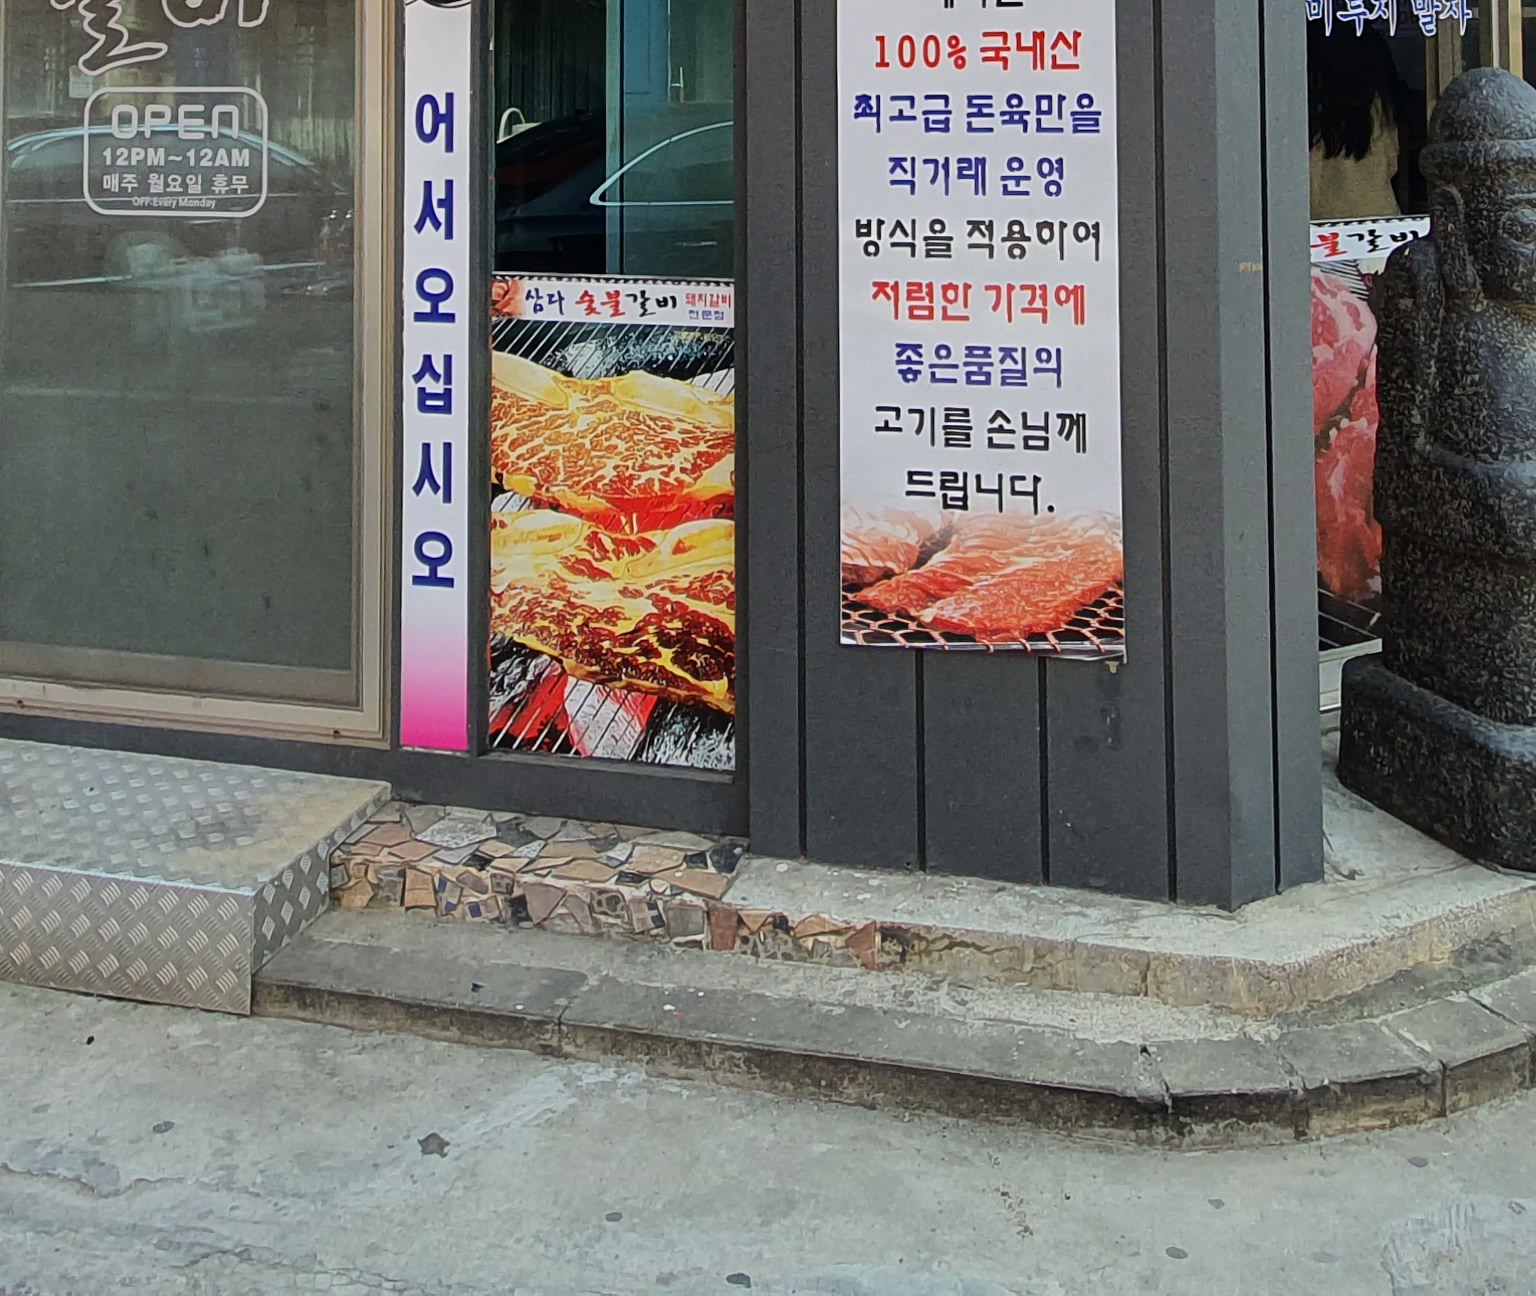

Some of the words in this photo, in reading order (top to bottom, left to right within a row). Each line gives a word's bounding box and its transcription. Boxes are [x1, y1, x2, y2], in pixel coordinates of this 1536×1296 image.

[874, 34, 967, 71] 100%
[979, 30, 1083, 71] 국내산
[112, 104, 239, 140] OPEN
[854, 93, 953, 134] 최고급
[965, 92, 1103, 135] 돈육만을
[102, 148, 250, 167] 12PM~12AM
[888, 156, 987, 197] 직거래
[1000, 156, 1064, 197] 운영
[103, 173, 139, 193] 매주
[148, 173, 202, 194] 월요일
[211, 174, 249, 194] 휴무
[855, 218, 954, 259] 방식을
[966, 219, 1102, 262] 적용하여
[525, 286, 566, 316] 삼다
[684, 292, 732, 309] 돼지갈비
[687, 308, 726, 321] 전문점
[871, 280, 972, 322] 저렴한
[984, 283, 1086, 326] 가격에
[410, 91, 456, 589] 어서오십시오
[874, 405, 974, 448] 고기를
[986, 406, 1088, 454] 손님께
[904, 469, 1057, 516] 드립니다.
